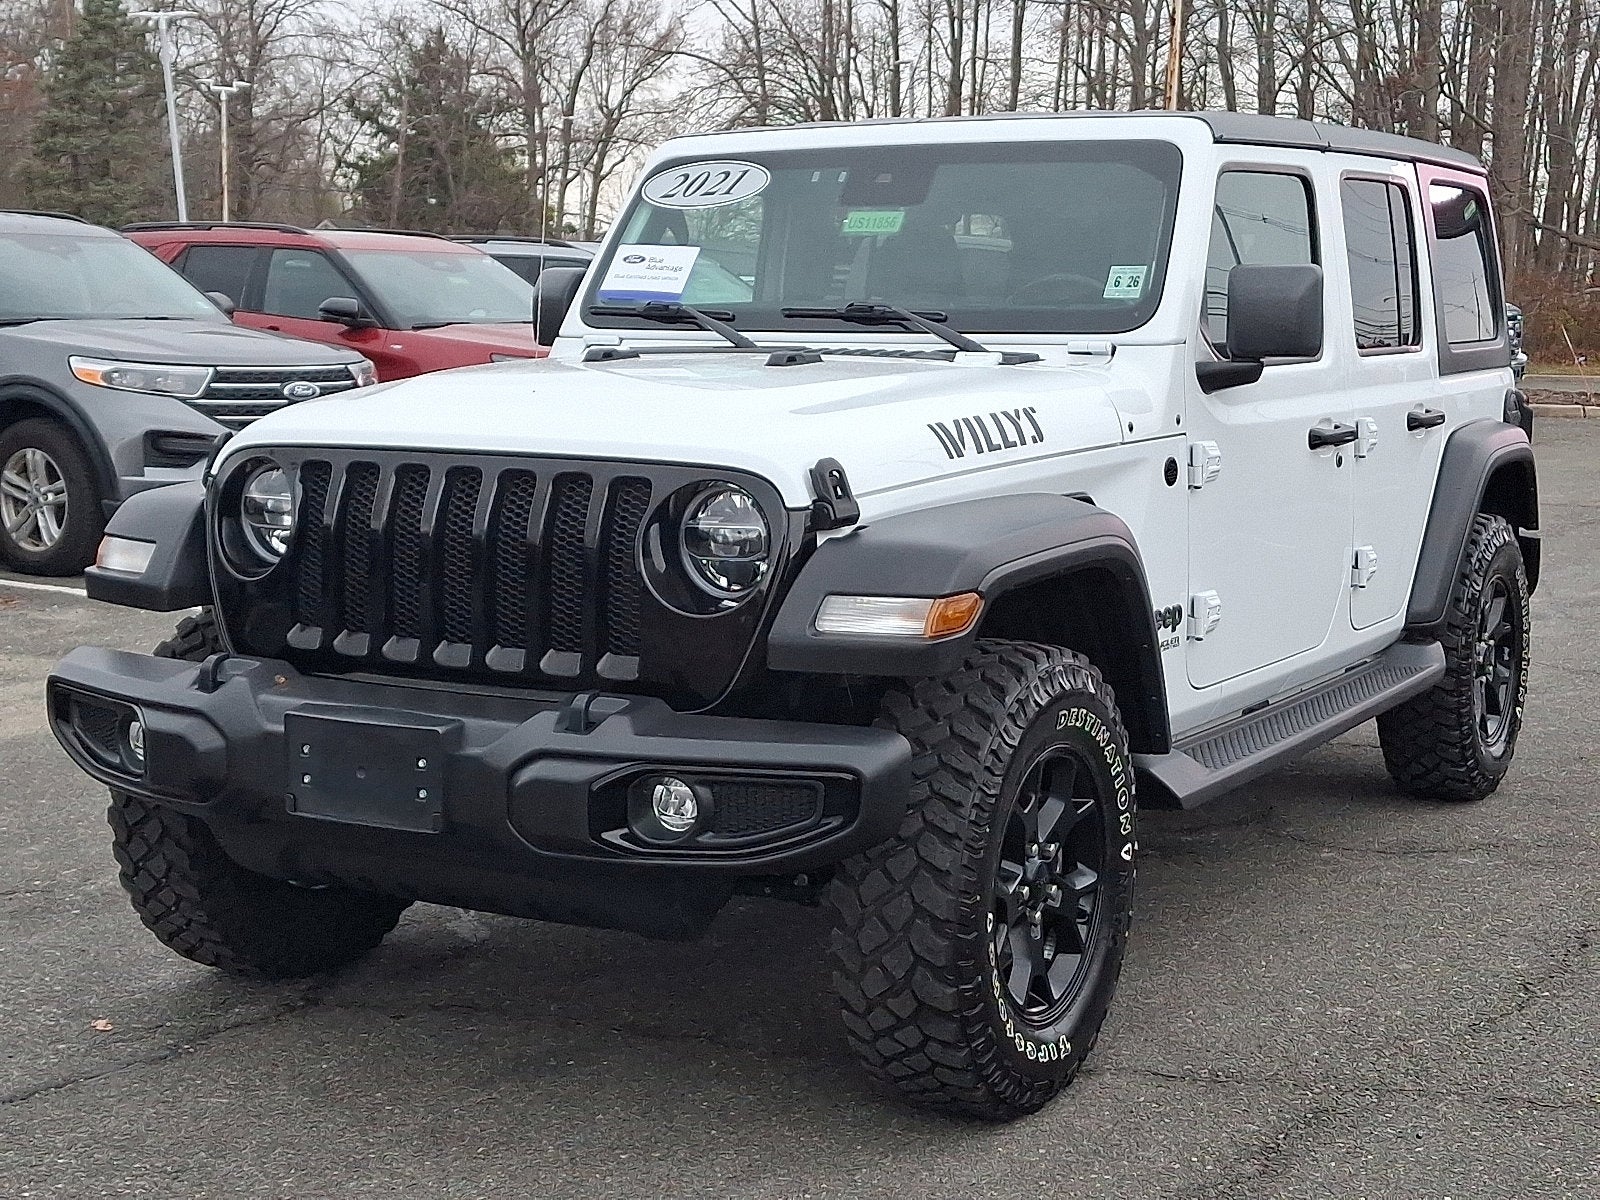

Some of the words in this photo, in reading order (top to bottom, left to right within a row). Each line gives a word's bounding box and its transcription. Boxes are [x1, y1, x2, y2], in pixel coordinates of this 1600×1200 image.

[659, 168, 751, 199] 2021
[645, 263, 684, 273] Advantage
[1113, 275, 1122, 288] 6
[1126, 275, 1141, 288] 26
[927, 406, 1044, 460] WILLYS
[1154, 603, 1183, 633] eep
[1056, 706, 1132, 836] DESTINATION
